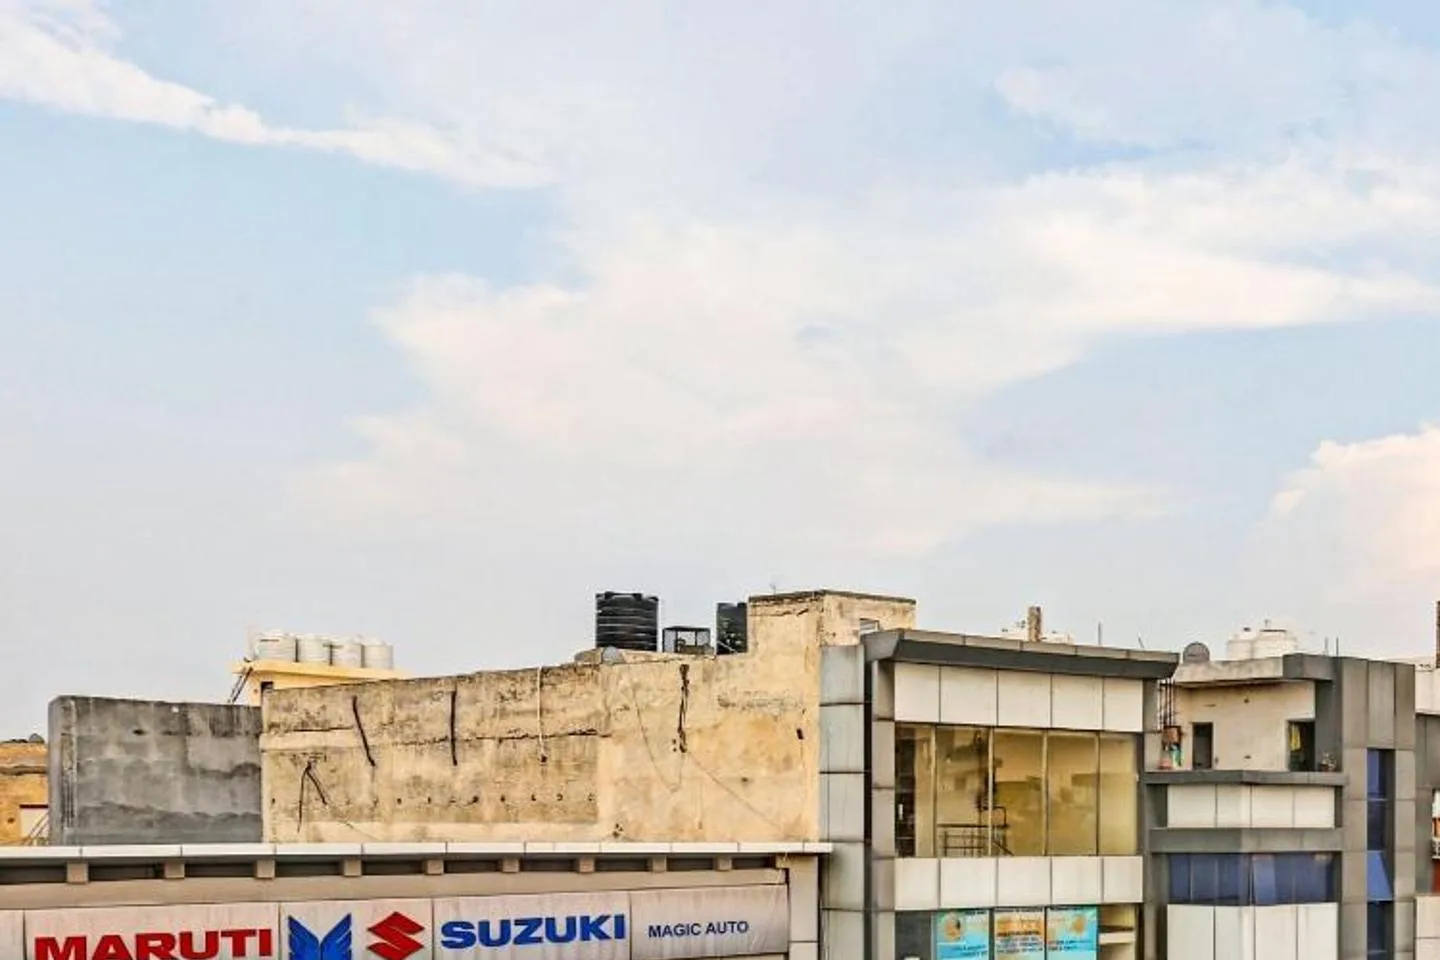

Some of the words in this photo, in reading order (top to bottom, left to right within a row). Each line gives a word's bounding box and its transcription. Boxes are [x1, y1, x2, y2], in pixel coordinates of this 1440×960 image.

[441, 914, 625, 949] SUZUKI
[648, 923, 701, 938] MAGIC
[705, 920, 749, 934] AUTO
